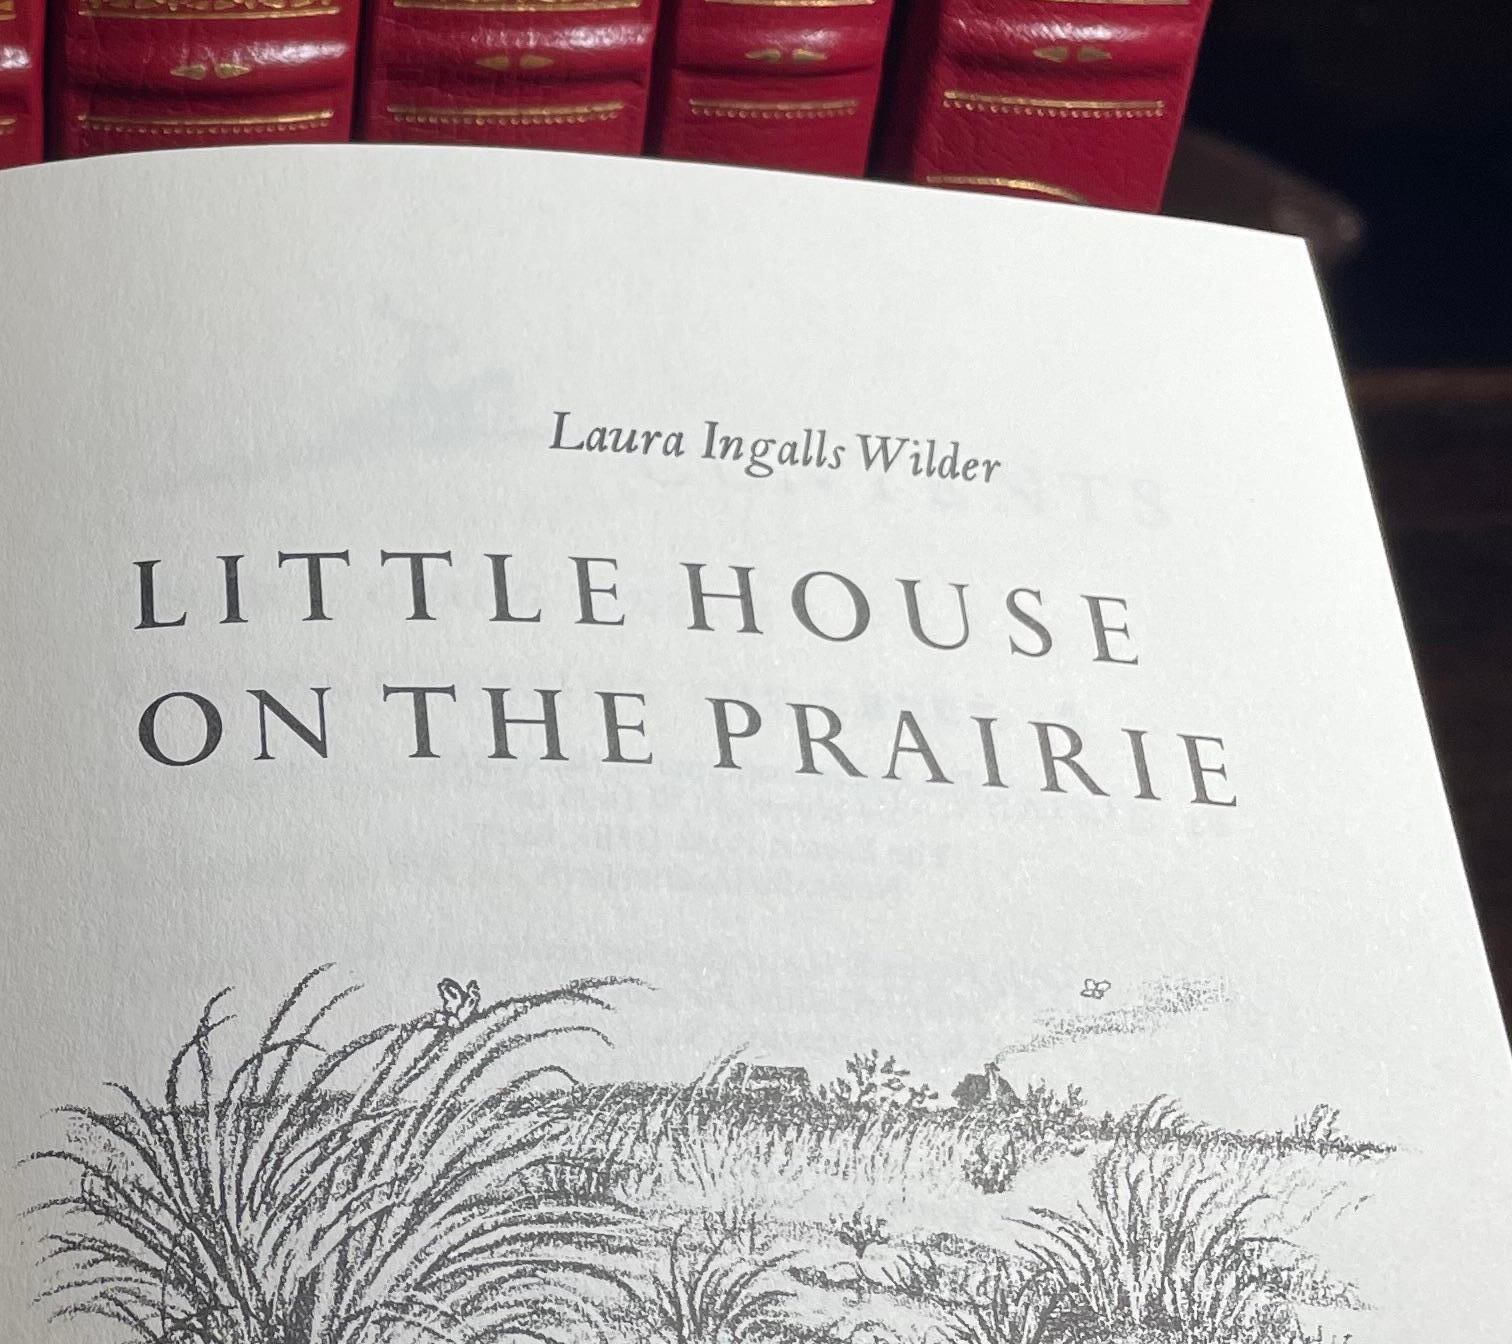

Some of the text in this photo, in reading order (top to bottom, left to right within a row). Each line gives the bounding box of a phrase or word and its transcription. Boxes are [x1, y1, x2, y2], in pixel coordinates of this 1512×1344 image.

[549, 411, 1001, 483] Laura Ingalls Wilder
[132, 549, 1138, 665] LITTLE HOUSE
[138, 684, 1236, 806] ON THE PRAIRIE
